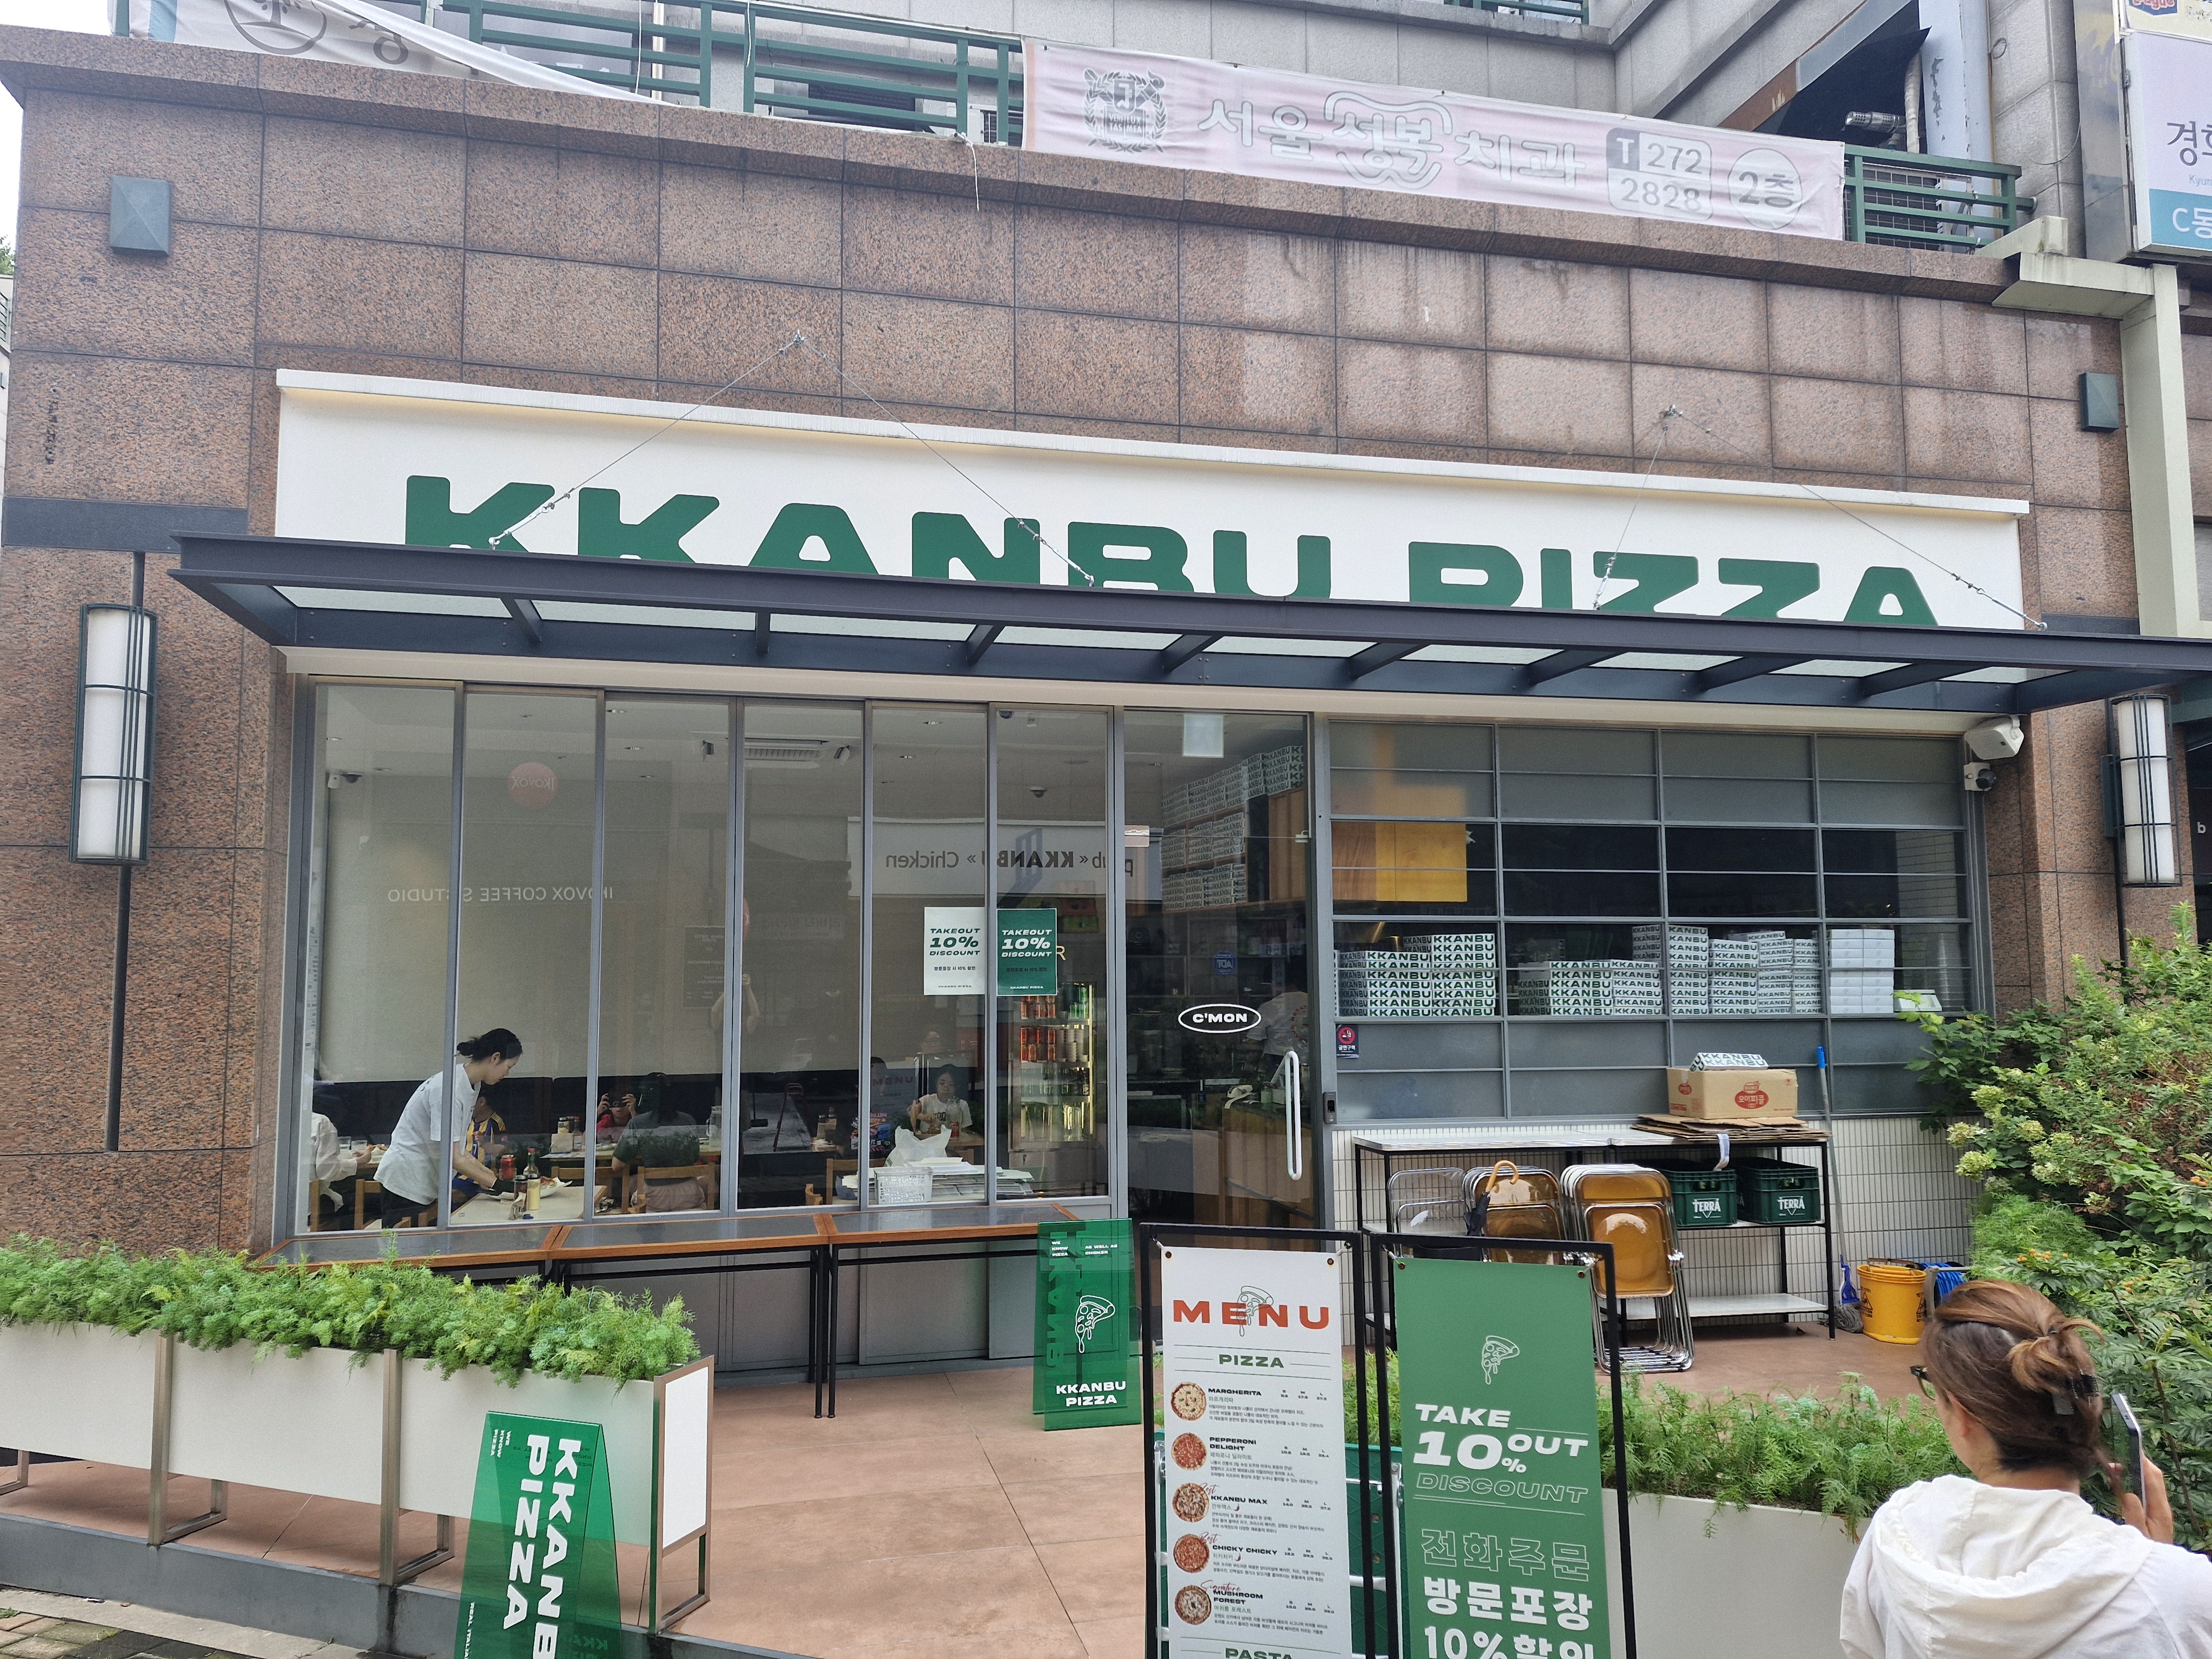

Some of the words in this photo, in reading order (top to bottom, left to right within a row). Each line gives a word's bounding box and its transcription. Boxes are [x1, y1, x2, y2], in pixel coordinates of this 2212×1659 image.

[1126, 115, 1141, 124] LUX
[1110, 123, 1123, 132] TAS
[1126, 125, 1142, 133] MEA
[1616, 138, 1635, 163] T
[1647, 142, 1703, 174] 272
[1621, 177, 1702, 211] 2828
[1739, 171, 1794, 208] 2층
[405, 475, 1331, 600] KKANBU
[1408, 541, 1939, 626] PIZZA
[930, 936, 979, 948] 10%
[1001, 937, 1051, 950] 10%
[1368, 952, 1428, 961] KKANBU
[1368, 971, 1429, 979] KKANBU
[1432, 971, 1493, 979] KKANBU
[1552, 971, 1611, 979] KKANBU
[1614, 971, 1659, 979] KKANBU
[1192, 1013, 1248, 1023] C'MON
[1692, 1201, 1721, 1213] TERRA
[1777, 1198, 1805, 1210] TERRA
[1173, 1300, 1329, 1330] MENU
[1219, 1354, 1285, 1369] PIZZA
[1056, 1381, 1126, 1395] KKANBU
[1208, 1388, 1262, 1396] MARGHERITA
[1066, 1395, 1117, 1407] PIZZA
[1415, 1404, 1511, 1428] TAKE
[505, 1431, 512, 1446] WE
[1507, 1434, 1588, 1457] OUT
[1413, 1431, 1526, 1473] 10%
[1416, 1473, 1588, 1504] DISCOUNT
[503, 1434, 550, 1630] PIZZA
[1421, 1528, 1589, 1582] 전화주문
[1213, 1590, 1263, 1599] MUSHROOM
[1424, 1577, 1593, 1631] 방문포장
[467, 1602, 476, 1627] REAL
[464, 1629, 472, 1659] ITALIA
